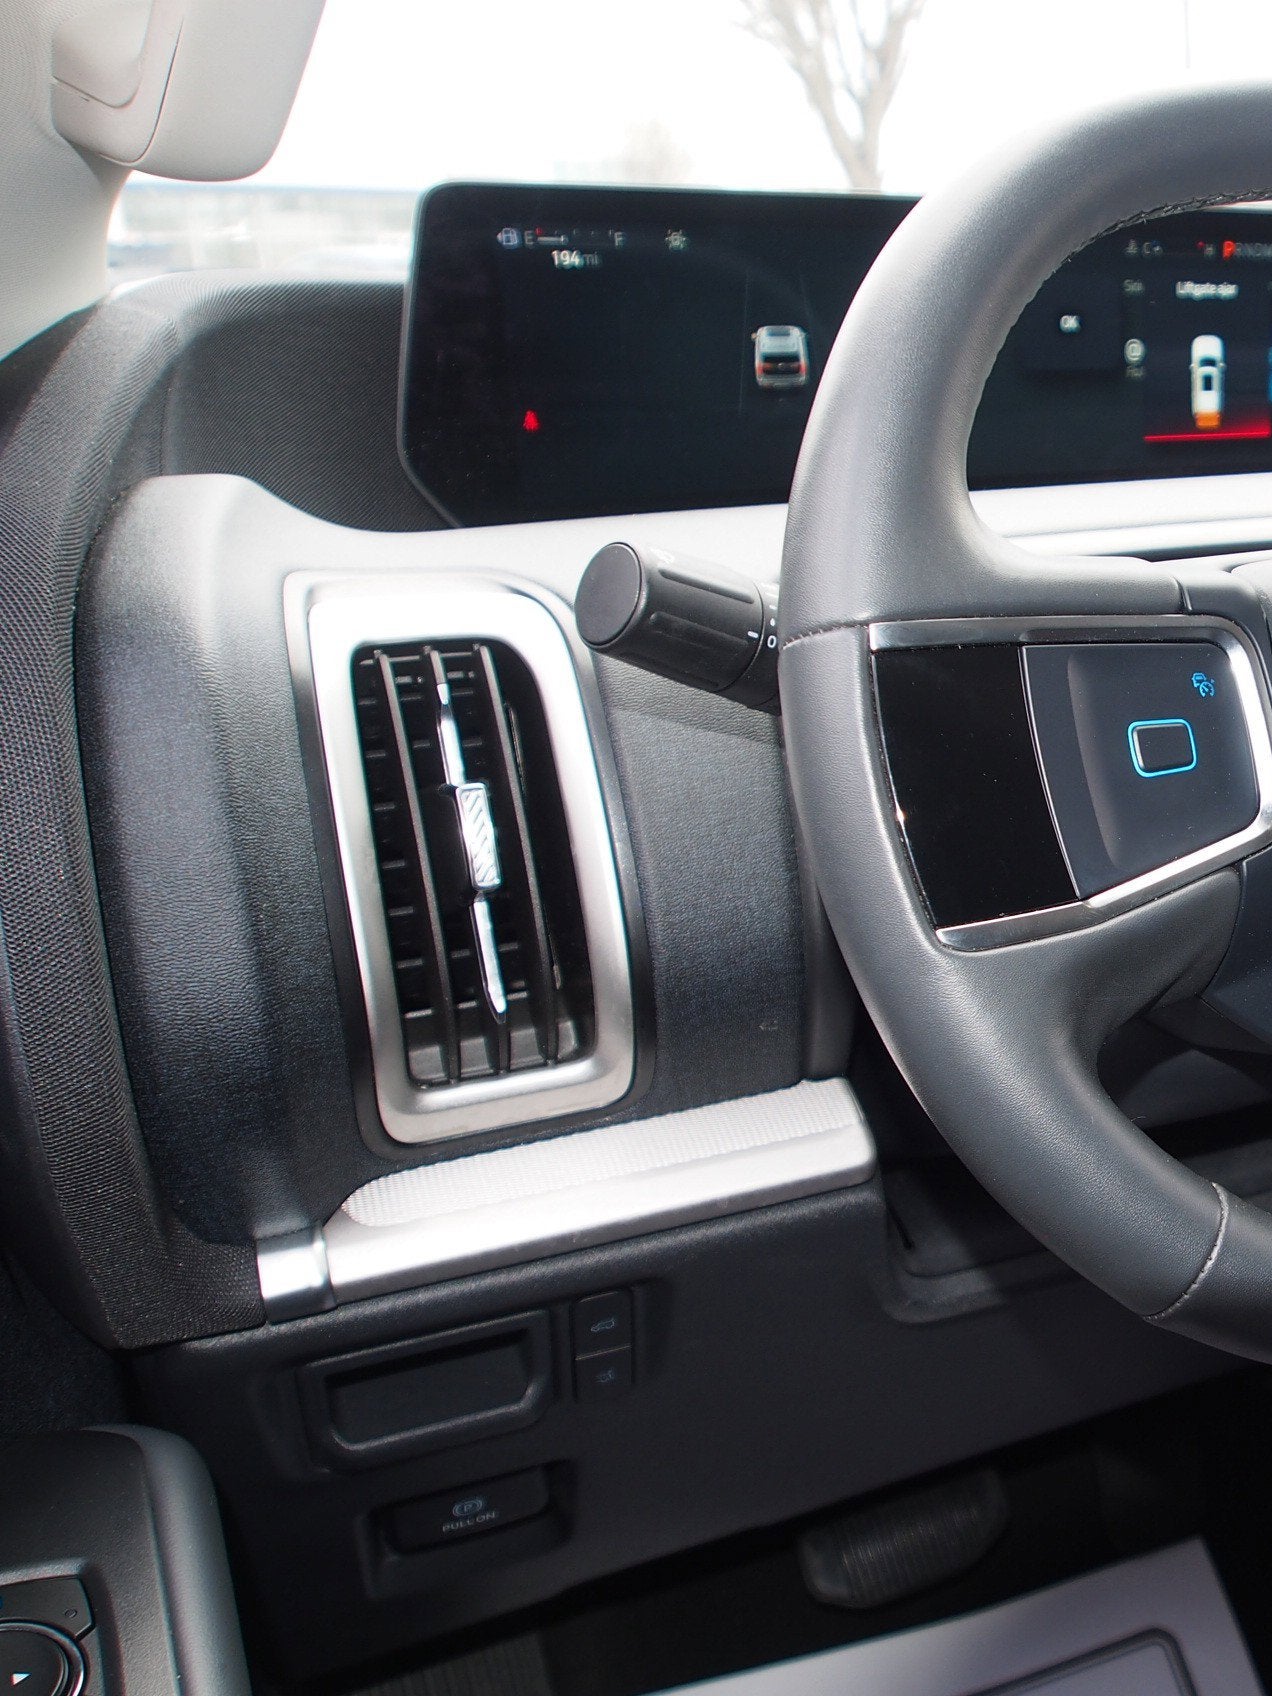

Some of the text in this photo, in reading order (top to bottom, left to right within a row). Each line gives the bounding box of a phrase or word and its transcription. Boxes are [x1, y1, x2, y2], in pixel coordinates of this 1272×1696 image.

[524, 230, 535, 246] E
[614, 231, 625, 247] F
[551, 250, 600, 267] 194 mi
[1175, 280, 1217, 299] Liftgate
[1059, 314, 1081, 332] OK
[442, 1511, 496, 1532] PULL ON
